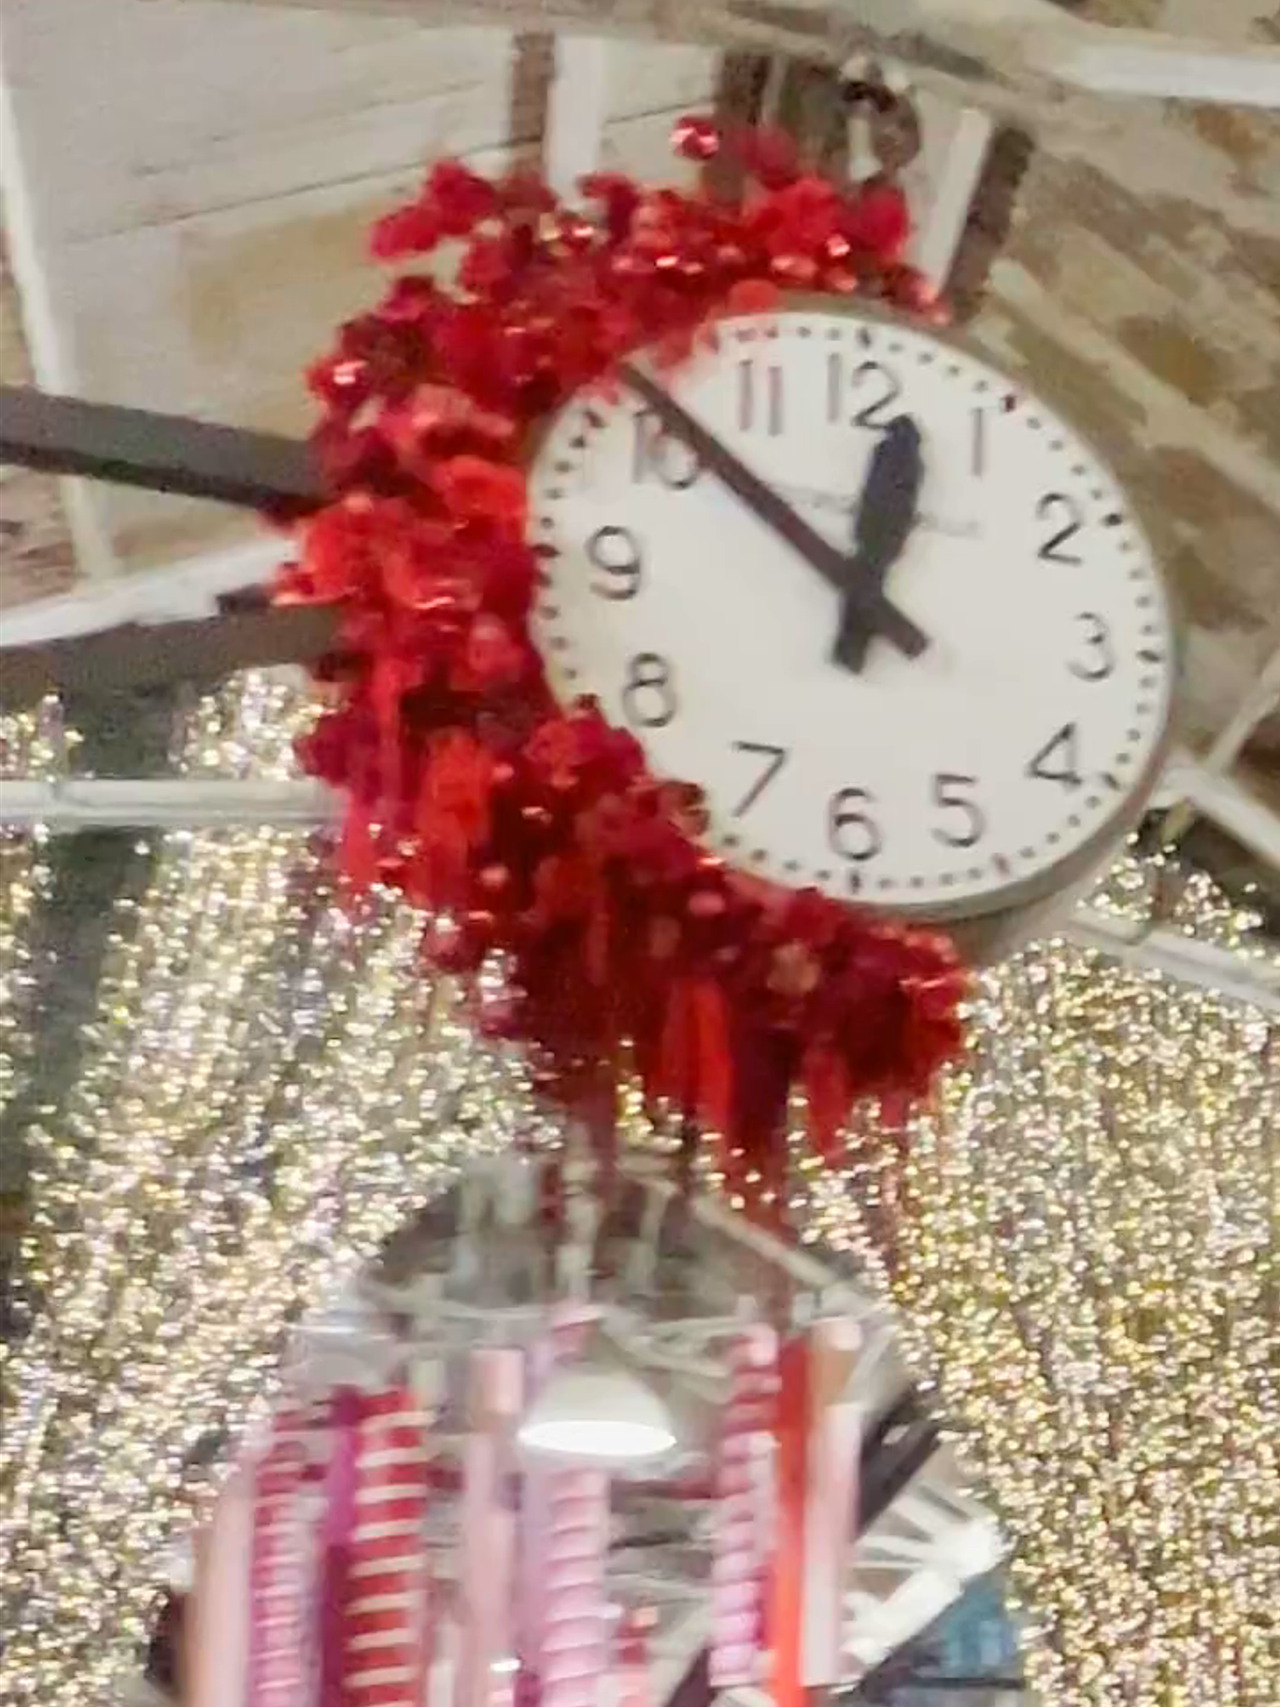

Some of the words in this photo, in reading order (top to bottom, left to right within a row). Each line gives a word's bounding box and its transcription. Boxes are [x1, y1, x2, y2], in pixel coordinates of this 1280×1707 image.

[738, 358, 783, 436] 11
[826, 353, 901, 432] 12
[970, 407, 988, 477] 1
[585, 524, 643, 601] 9
[1037, 492, 1084, 566] 2
[1067, 611, 1113, 682] 3
[621, 652, 677, 729] 8
[730, 740, 789, 818] 7
[1027, 722, 1084, 791] 4
[827, 786, 882, 862] 6
[929, 773, 986, 849] 5
